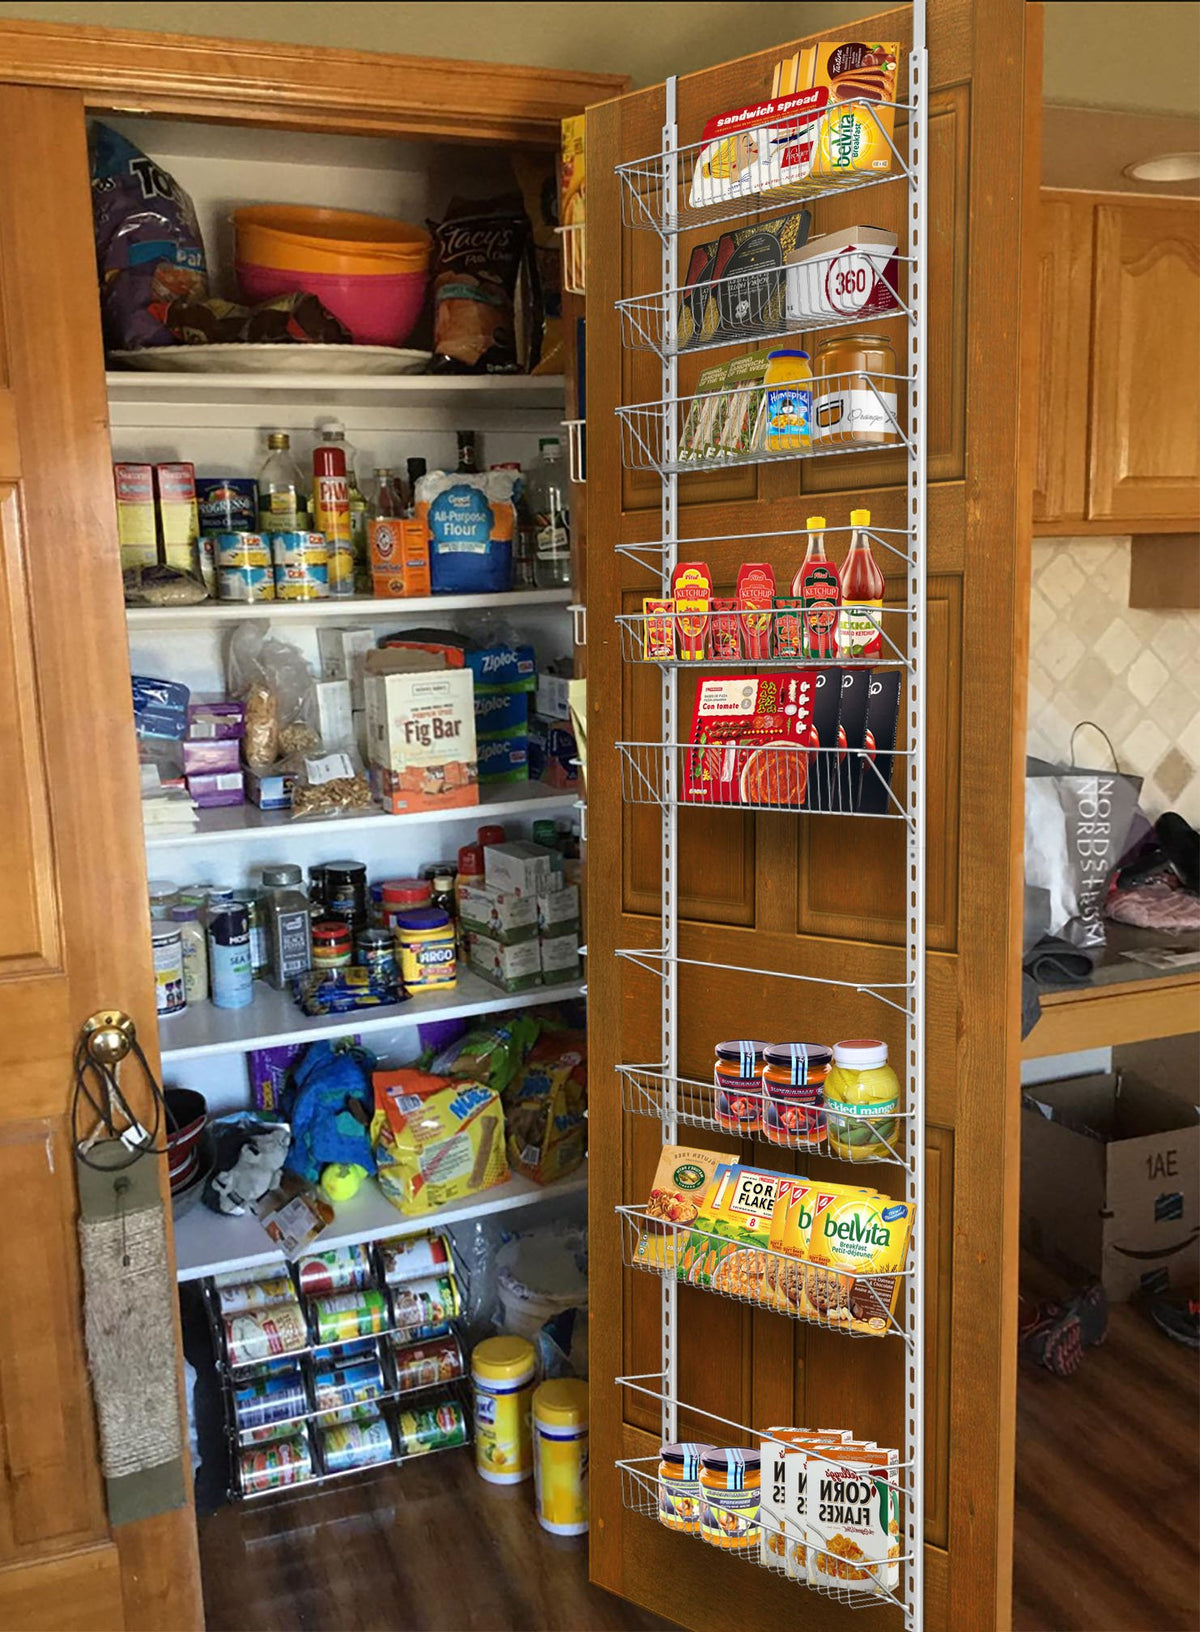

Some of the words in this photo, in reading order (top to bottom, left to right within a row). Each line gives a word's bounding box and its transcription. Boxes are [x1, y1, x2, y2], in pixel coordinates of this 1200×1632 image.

[716, 104, 775, 127] sandwich
[777, 91, 819, 112] spread
[852, 123, 862, 158] Breakfast
[835, 268, 866, 296] 360
[320, 480, 349, 501] PAM
[434, 510, 487, 524] All-Purpose
[443, 522, 477, 537] Flour
[676, 589, 708, 597] KETCHUP
[741, 589, 773, 598] KETCHUP
[805, 587, 837, 597] KETCHUP
[482, 651, 518, 673] Ziploc
[474, 696, 511, 716] Ziploc
[404, 721, 432, 747] Fig
[433, 717, 462, 741] Bar
[230, 956, 246, 966] SEA
[420, 949, 453, 963] ARGO
[828, 1099, 857, 1115] ickled
[859, 1103, 896, 1116] mango
[742, 1181, 777, 1198] COR
[738, 1193, 775, 1211] FLAKE
[749, 1218, 756, 1227] 8
[824, 1211, 891, 1247] belVita
[831, 1246, 874, 1259] Petit-déjeuner
[839, 1241, 867, 1252] Breakfast
